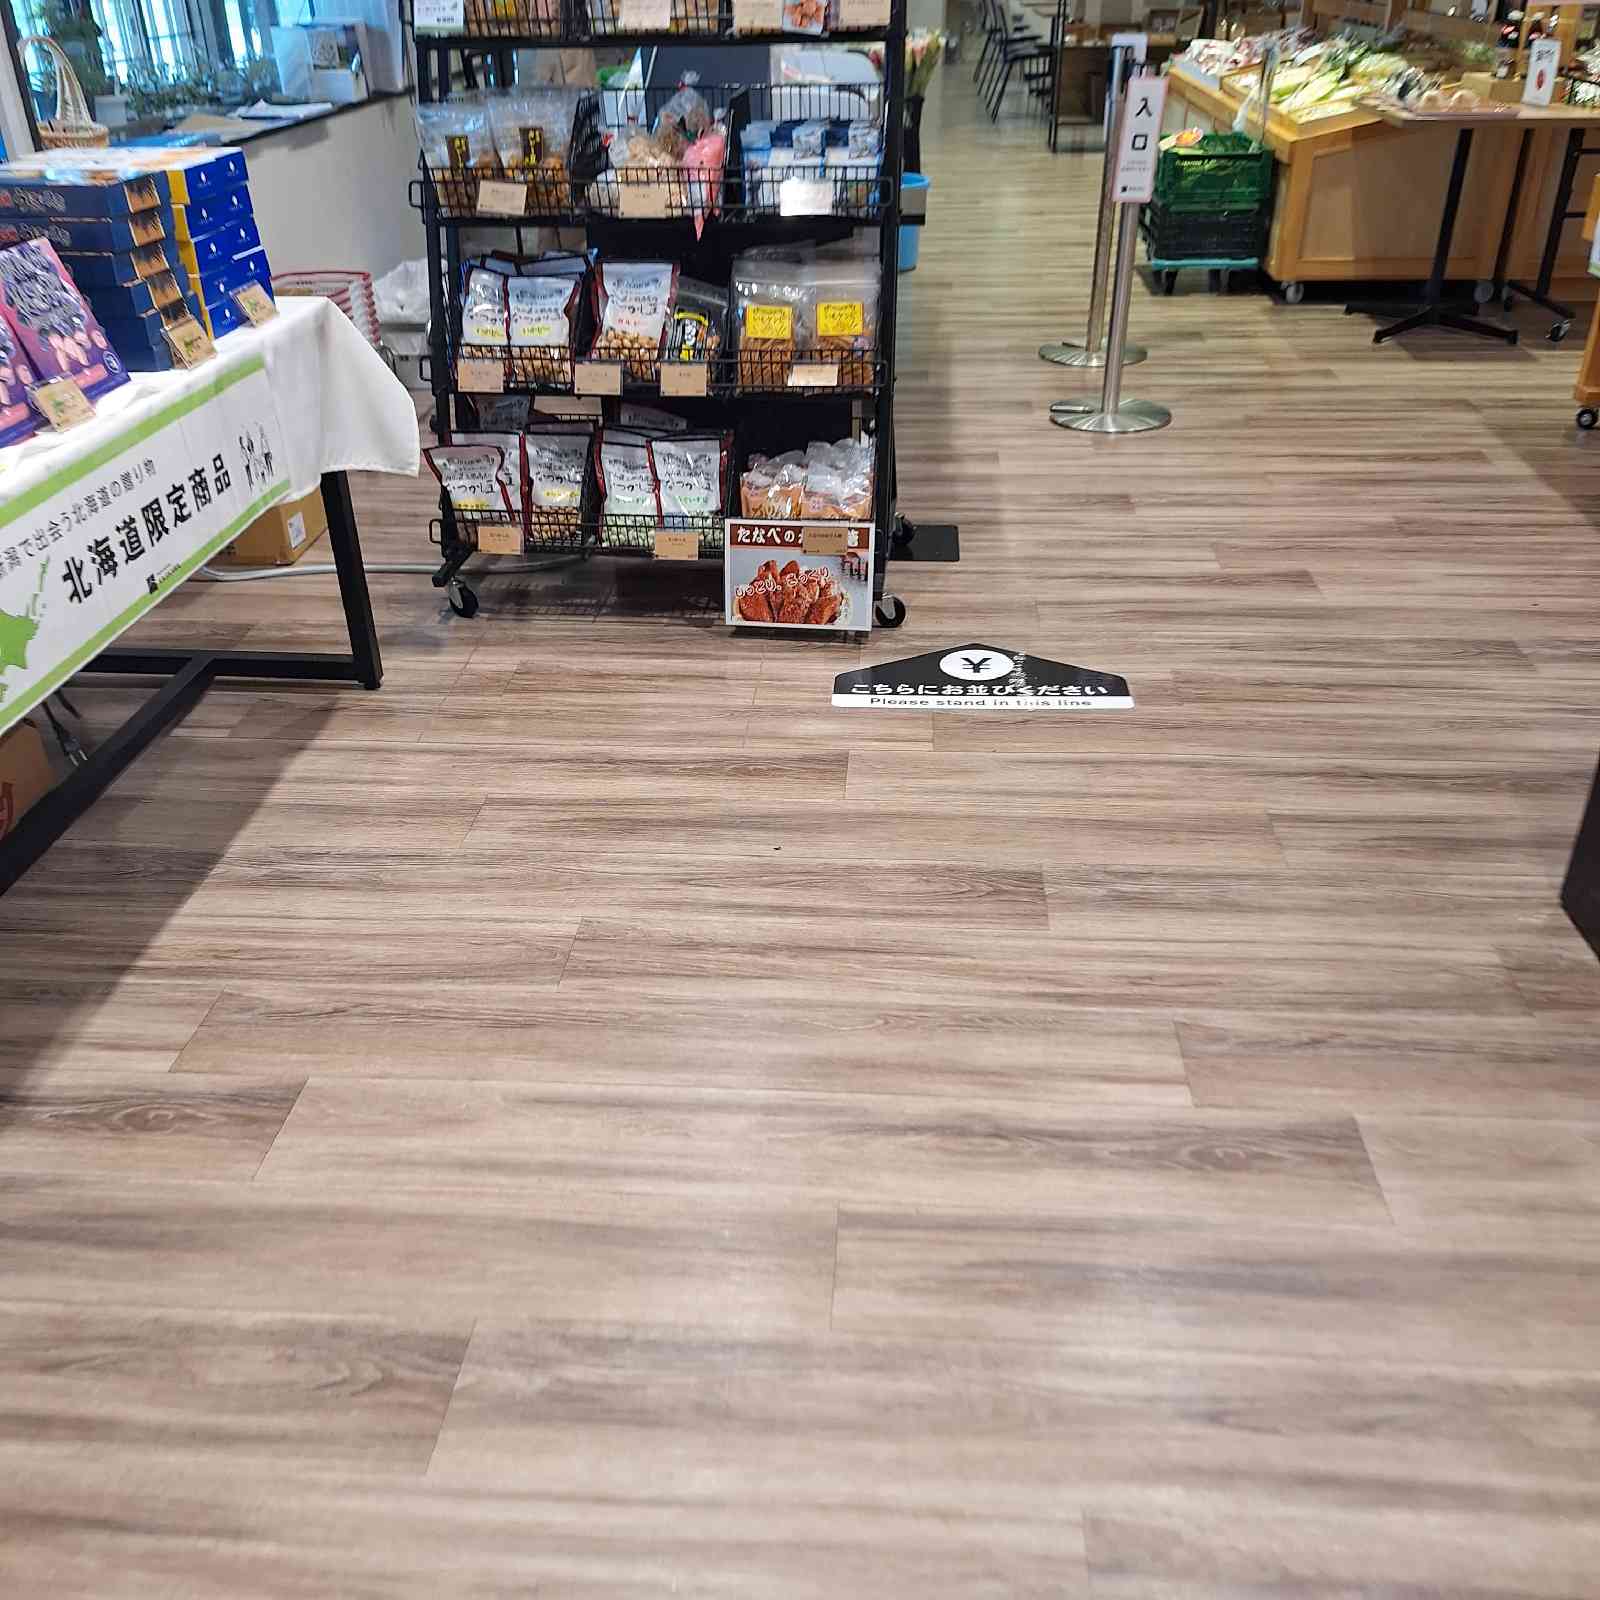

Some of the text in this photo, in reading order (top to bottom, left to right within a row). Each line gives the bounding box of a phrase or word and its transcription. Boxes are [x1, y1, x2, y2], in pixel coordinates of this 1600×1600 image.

[1132, 97, 1152, 151] 入口
[0, 457, 157, 578] で出会う北海道の贈り物
[61, 452, 232, 604] 北海道限定商品
[850, 683, 1109, 696] こちらにお並びください
[870, 698, 930, 706] Please
[936, 698, 986, 706] stand
